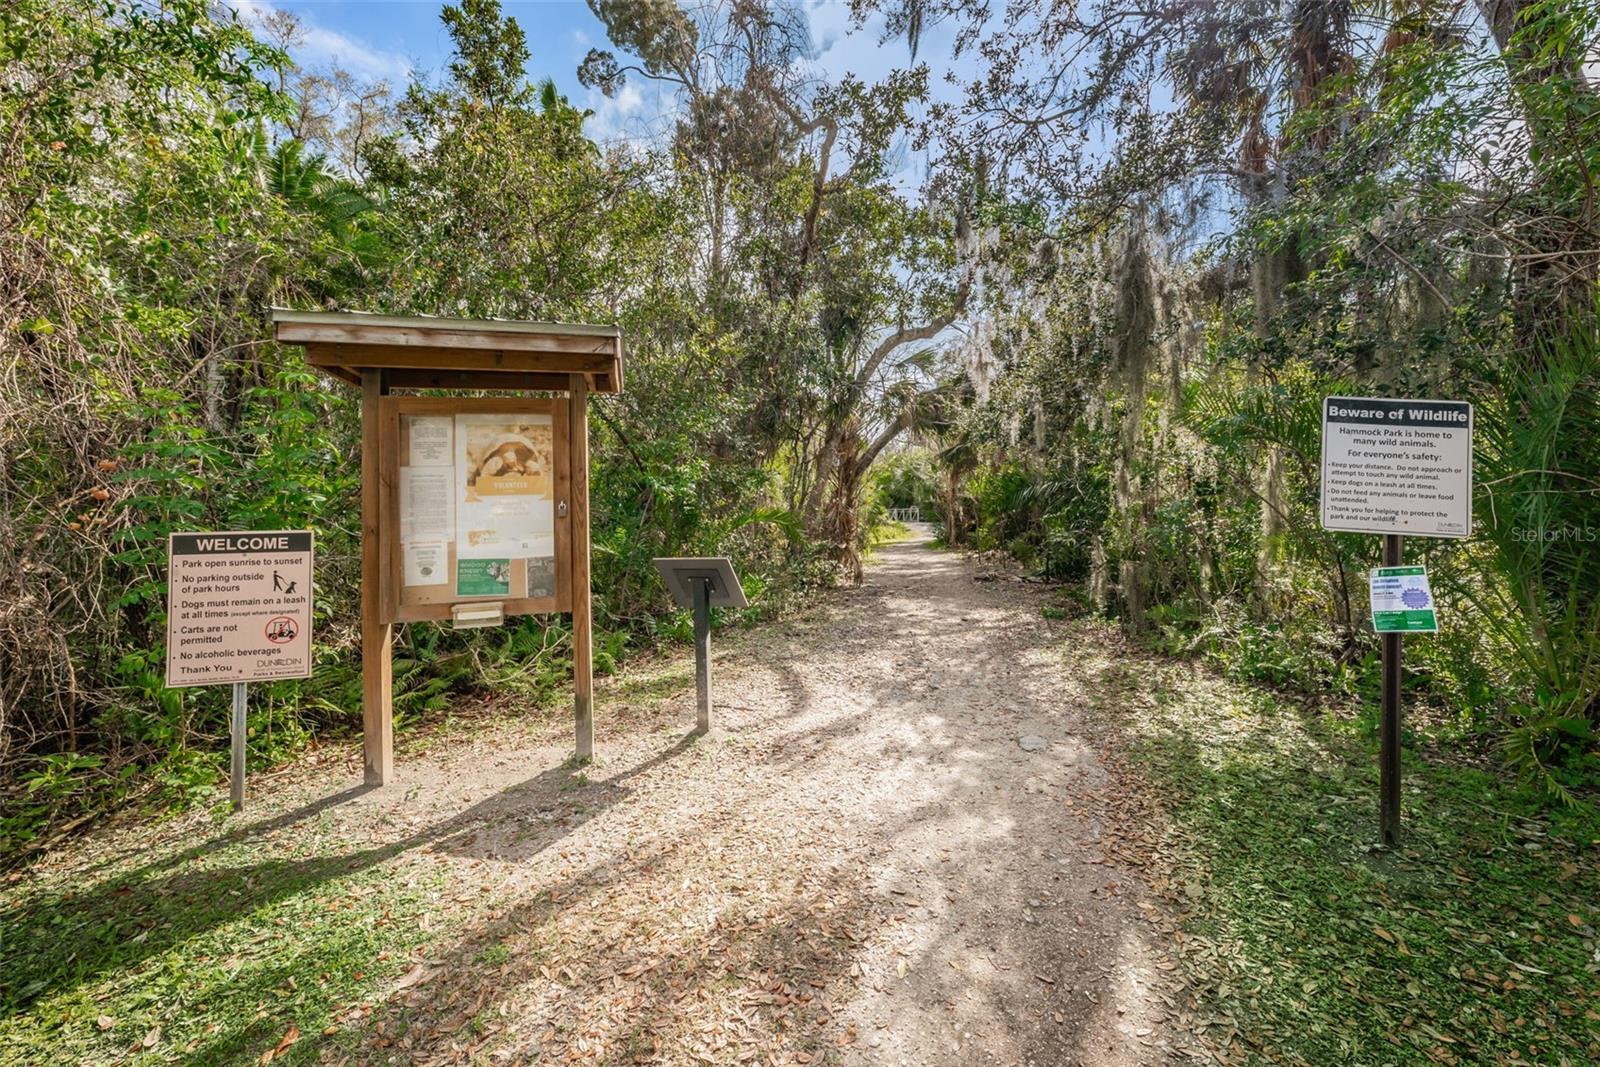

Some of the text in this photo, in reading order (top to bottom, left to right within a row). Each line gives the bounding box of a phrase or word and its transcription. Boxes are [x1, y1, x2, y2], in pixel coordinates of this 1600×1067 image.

[1329, 406, 1467, 422] Beware of Wildlife
[1339, 428, 1381, 436] Hammock
[1364, 451, 1410, 460] everyone's
[1412, 452, 1442, 461] safety:
[196, 537, 289, 551] WELCOME
[197, 574, 230, 583] parking
[193, 586, 213, 594] park
[182, 601, 204, 609] Dogs
[181, 635, 222, 645] permitted
[237, 648, 281, 657] beverages
[181, 666, 211, 674] Thank
